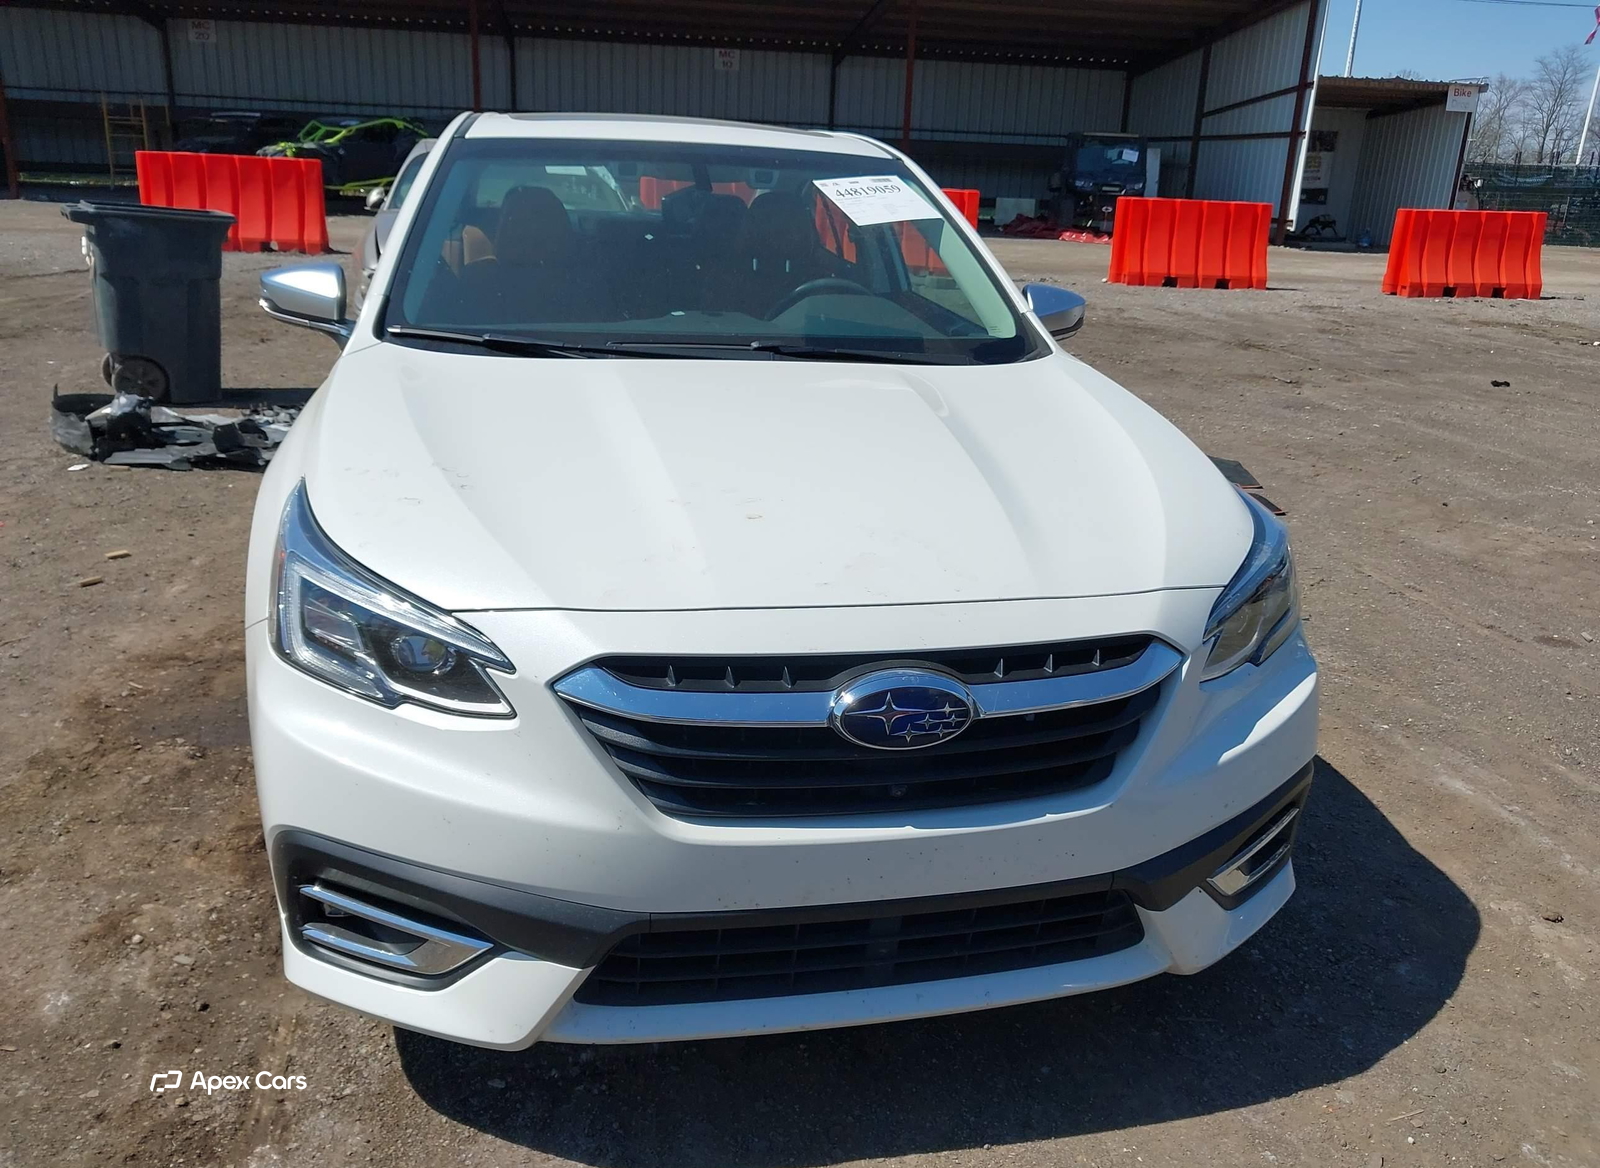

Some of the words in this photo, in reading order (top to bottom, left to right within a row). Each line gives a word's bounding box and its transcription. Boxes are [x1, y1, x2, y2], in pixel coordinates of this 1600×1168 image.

[191, 20, 210, 30] MC
[718, 50, 736, 59] MC
[1453, 87, 1472, 98] Bike
[835, 184, 902, 198] 44819059
